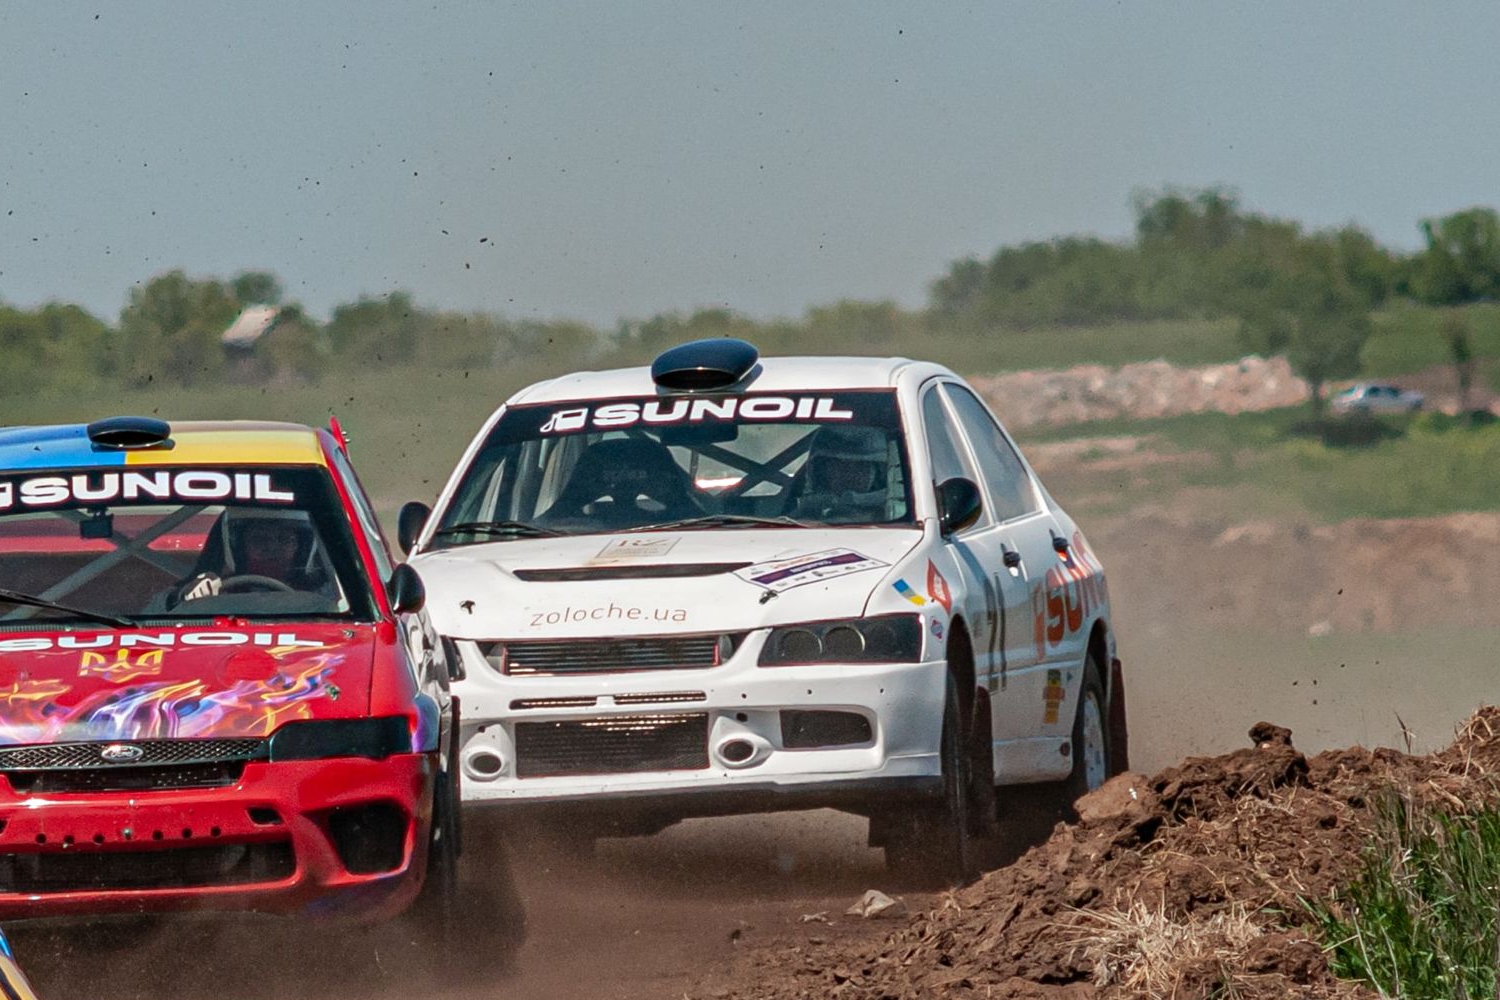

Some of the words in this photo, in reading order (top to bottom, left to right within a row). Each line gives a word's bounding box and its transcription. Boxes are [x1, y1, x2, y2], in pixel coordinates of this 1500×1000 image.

[592, 397, 853, 426] SUNOIL
[20, 471, 295, 504] SUNOIL
[530, 603, 688, 627] zoloche.ua
